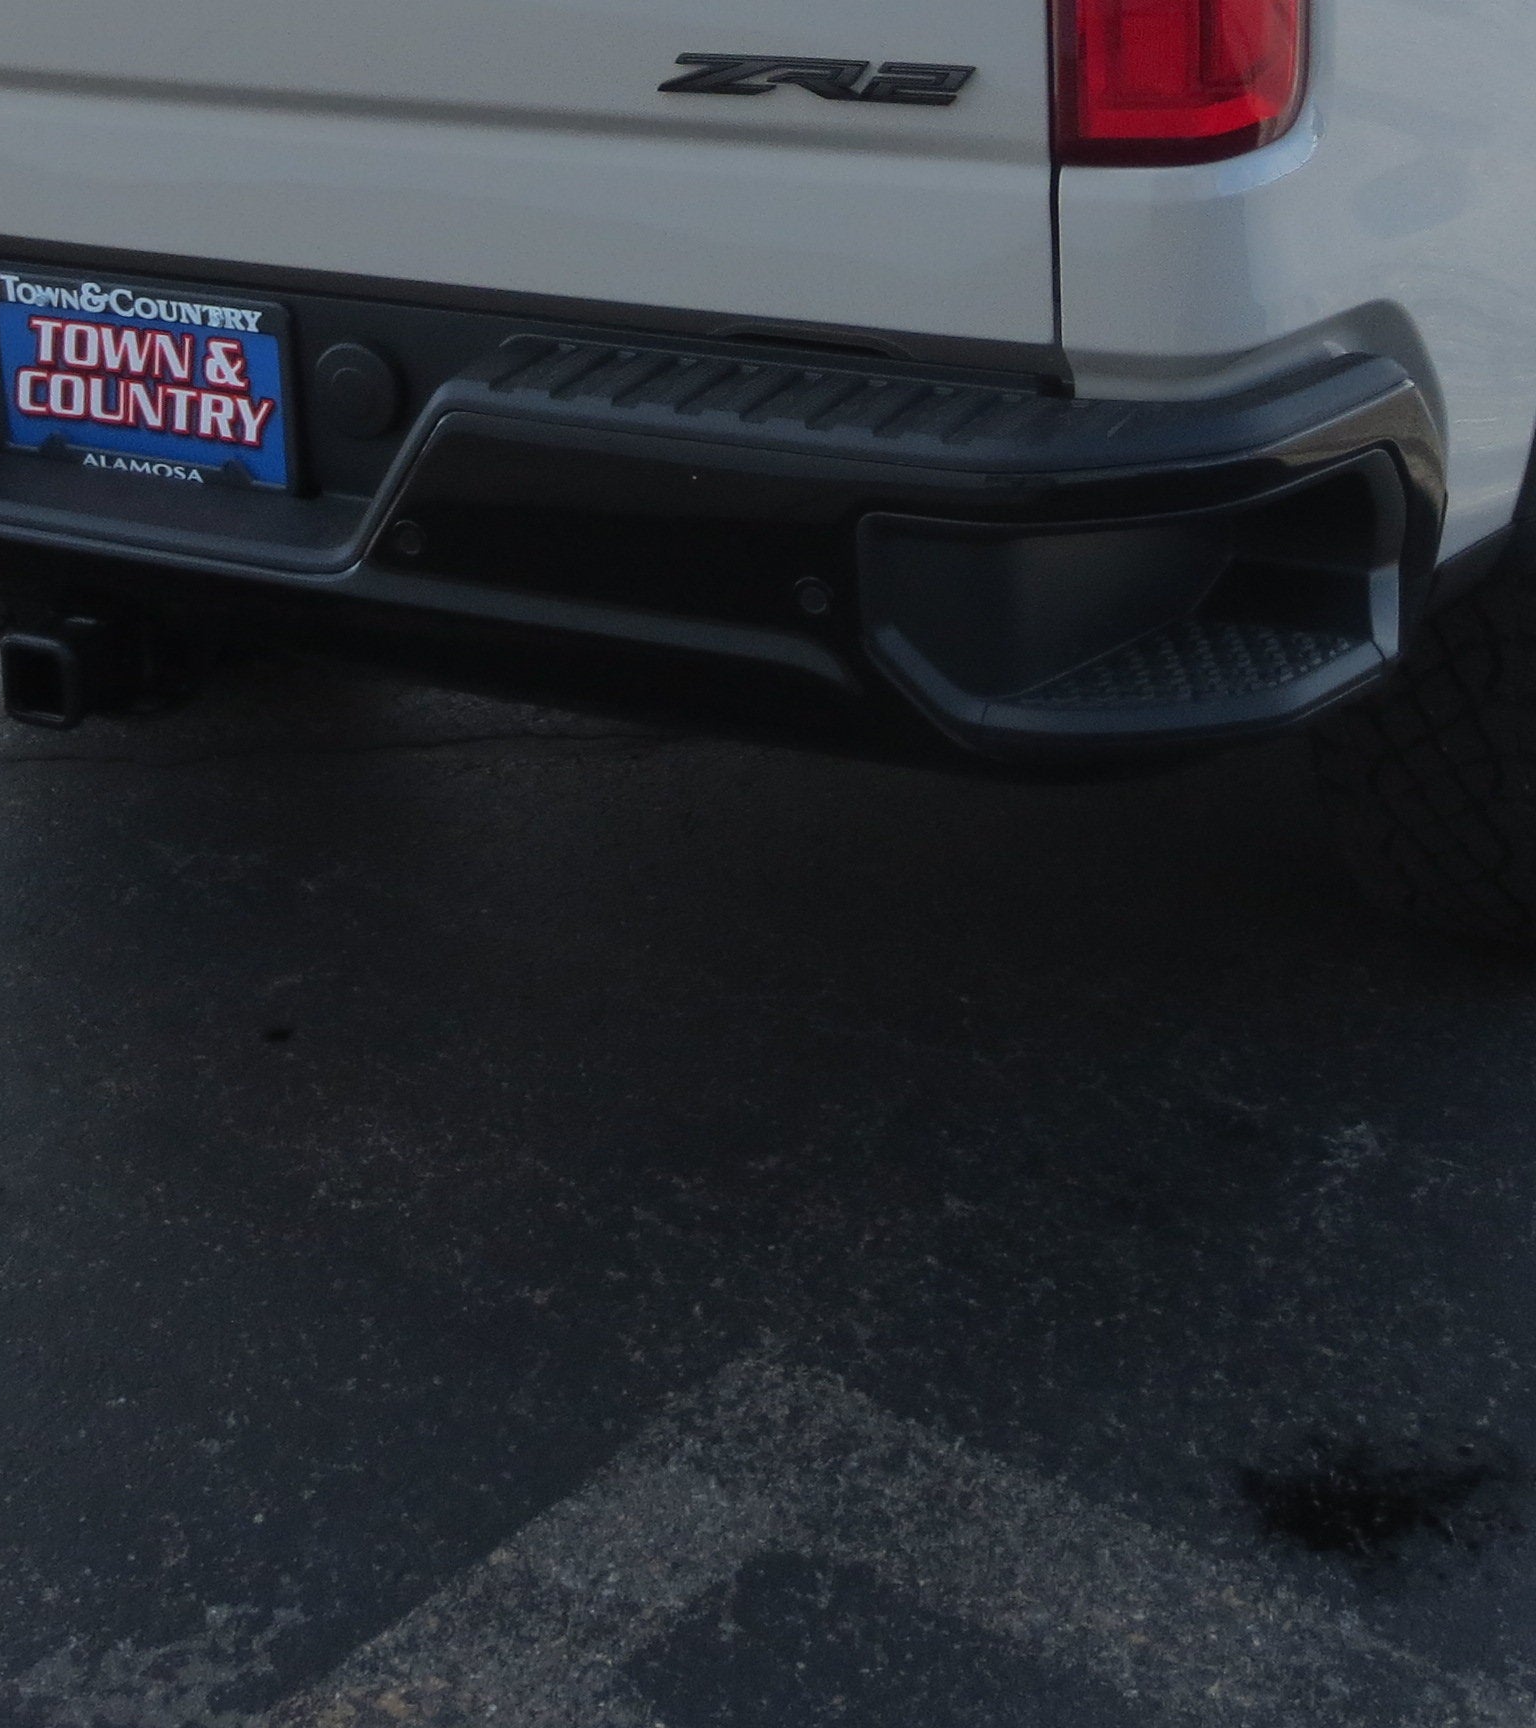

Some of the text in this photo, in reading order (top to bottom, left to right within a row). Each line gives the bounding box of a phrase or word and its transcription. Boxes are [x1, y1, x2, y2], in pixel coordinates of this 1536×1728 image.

[658, 52, 977, 107] ZR2
[29, 315, 250, 391] TOWN &
[16, 367, 274, 448] COUNTRY
[82, 452, 205, 484] ALAMOSA
